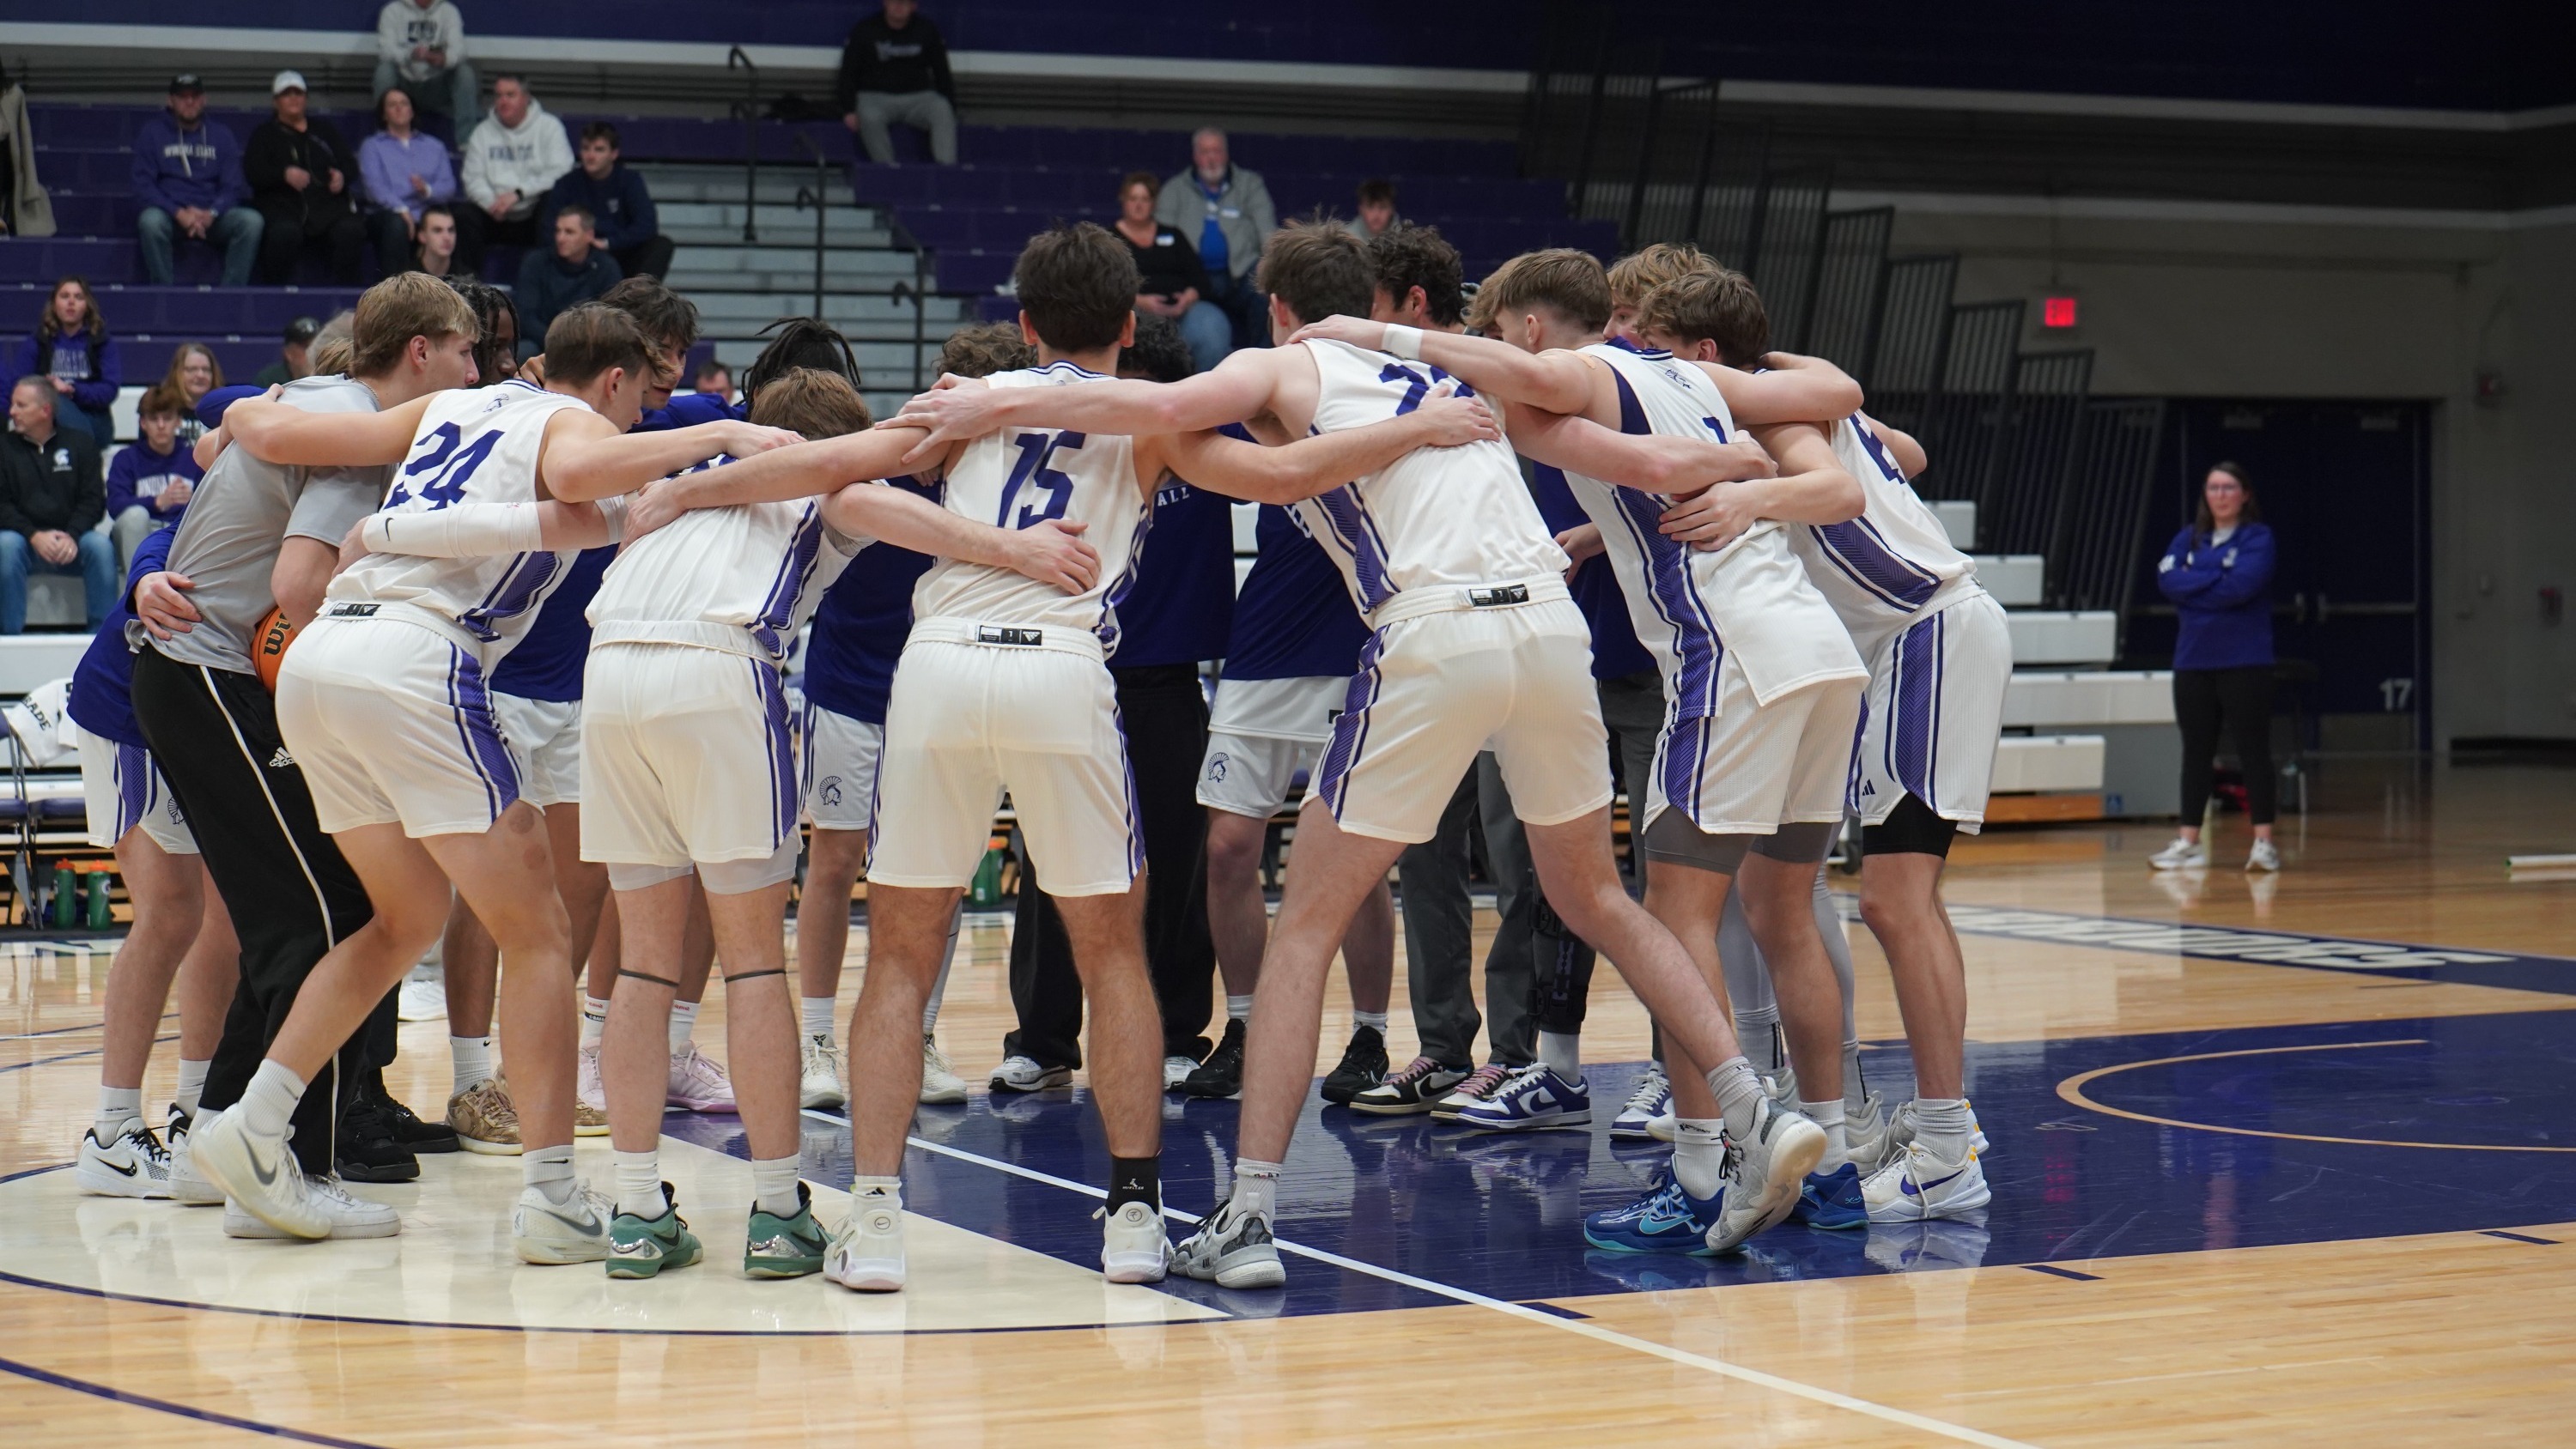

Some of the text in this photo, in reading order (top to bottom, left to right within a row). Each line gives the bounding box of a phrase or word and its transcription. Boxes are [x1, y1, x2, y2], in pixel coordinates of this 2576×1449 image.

[383, 421, 507, 512] 24
[997, 430, 1086, 530] 15
[2379, 677, 2413, 712] 17
